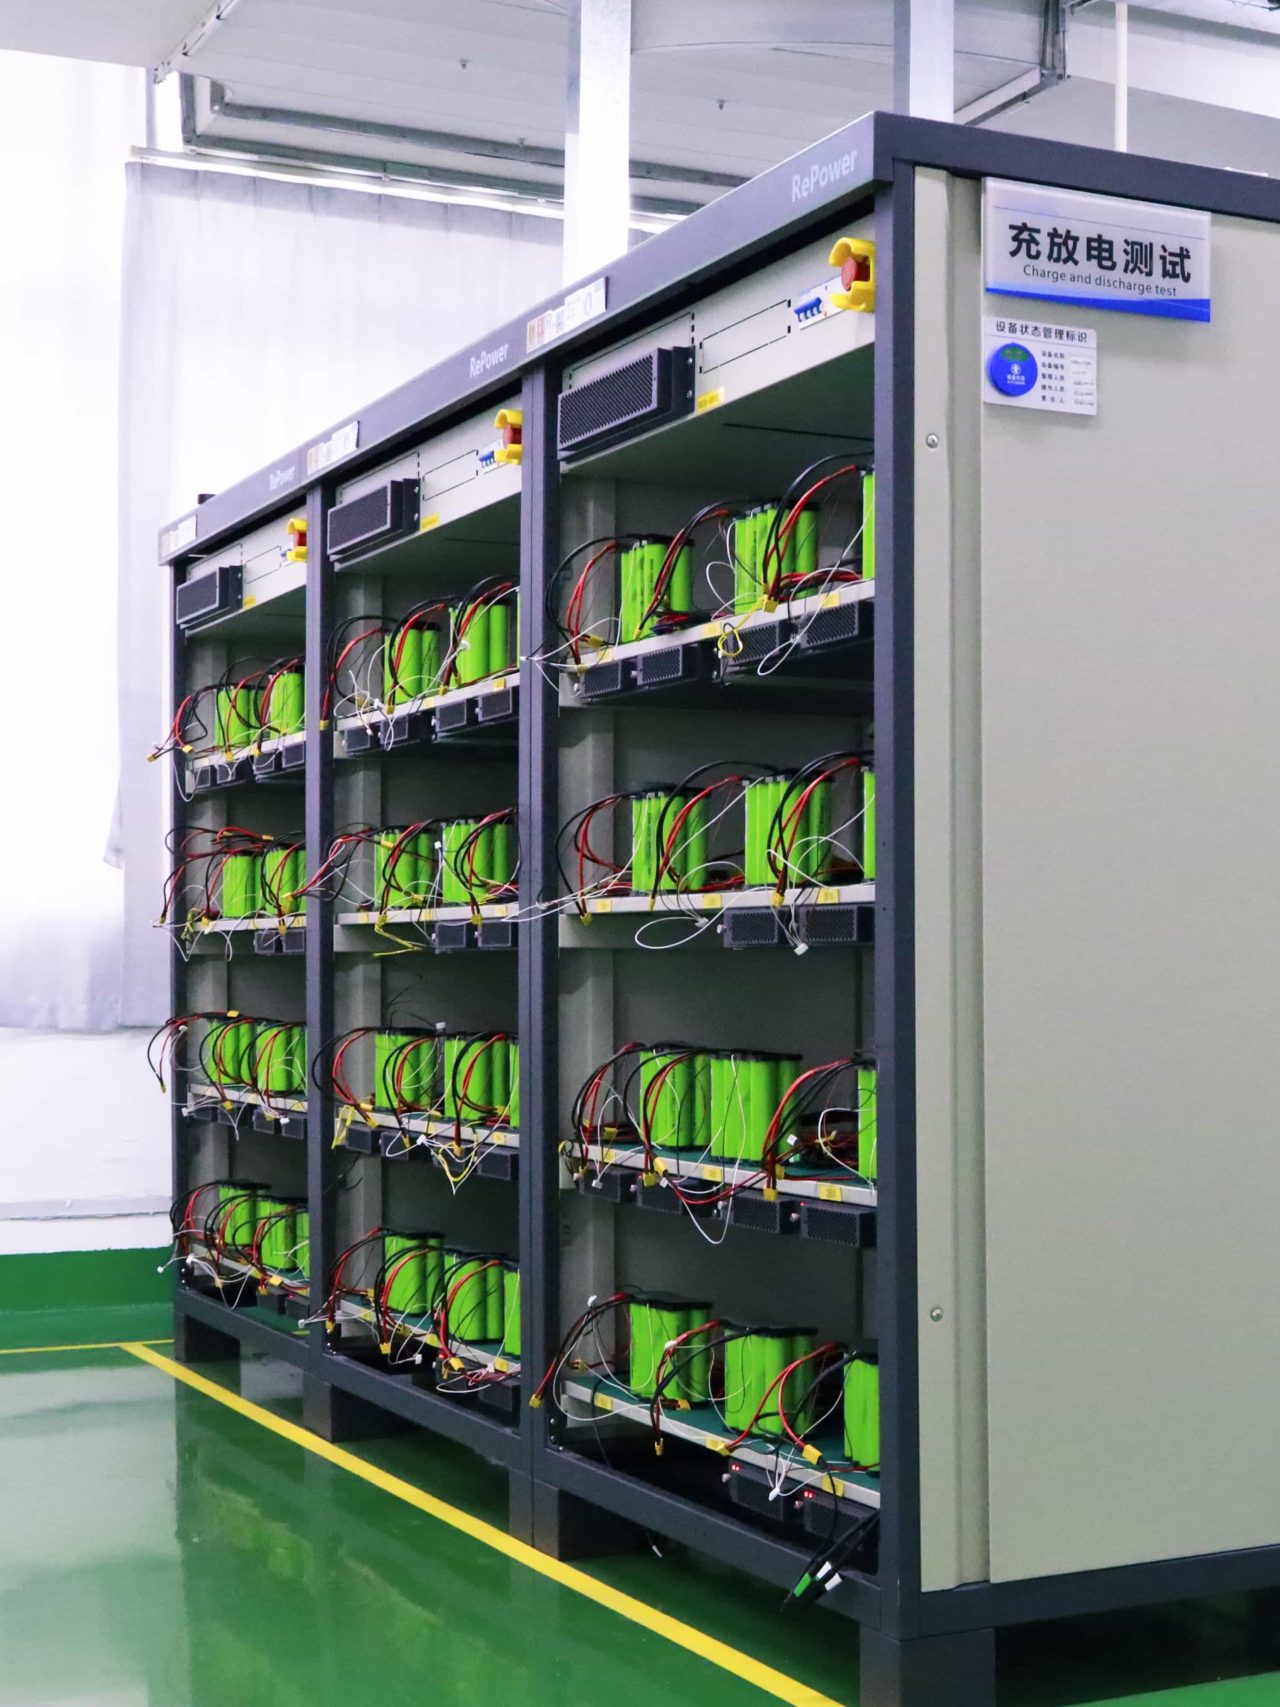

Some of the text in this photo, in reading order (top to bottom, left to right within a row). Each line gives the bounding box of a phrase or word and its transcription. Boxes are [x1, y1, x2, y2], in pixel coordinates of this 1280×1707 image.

[792, 150, 857, 202] RePower
[1008, 222, 1191, 283] 充放电测试
[1023, 264, 1177, 296] Charge and discharge test
[996, 320, 1088, 343] 设备状态管理标识
[470, 344, 509, 378] RePower
